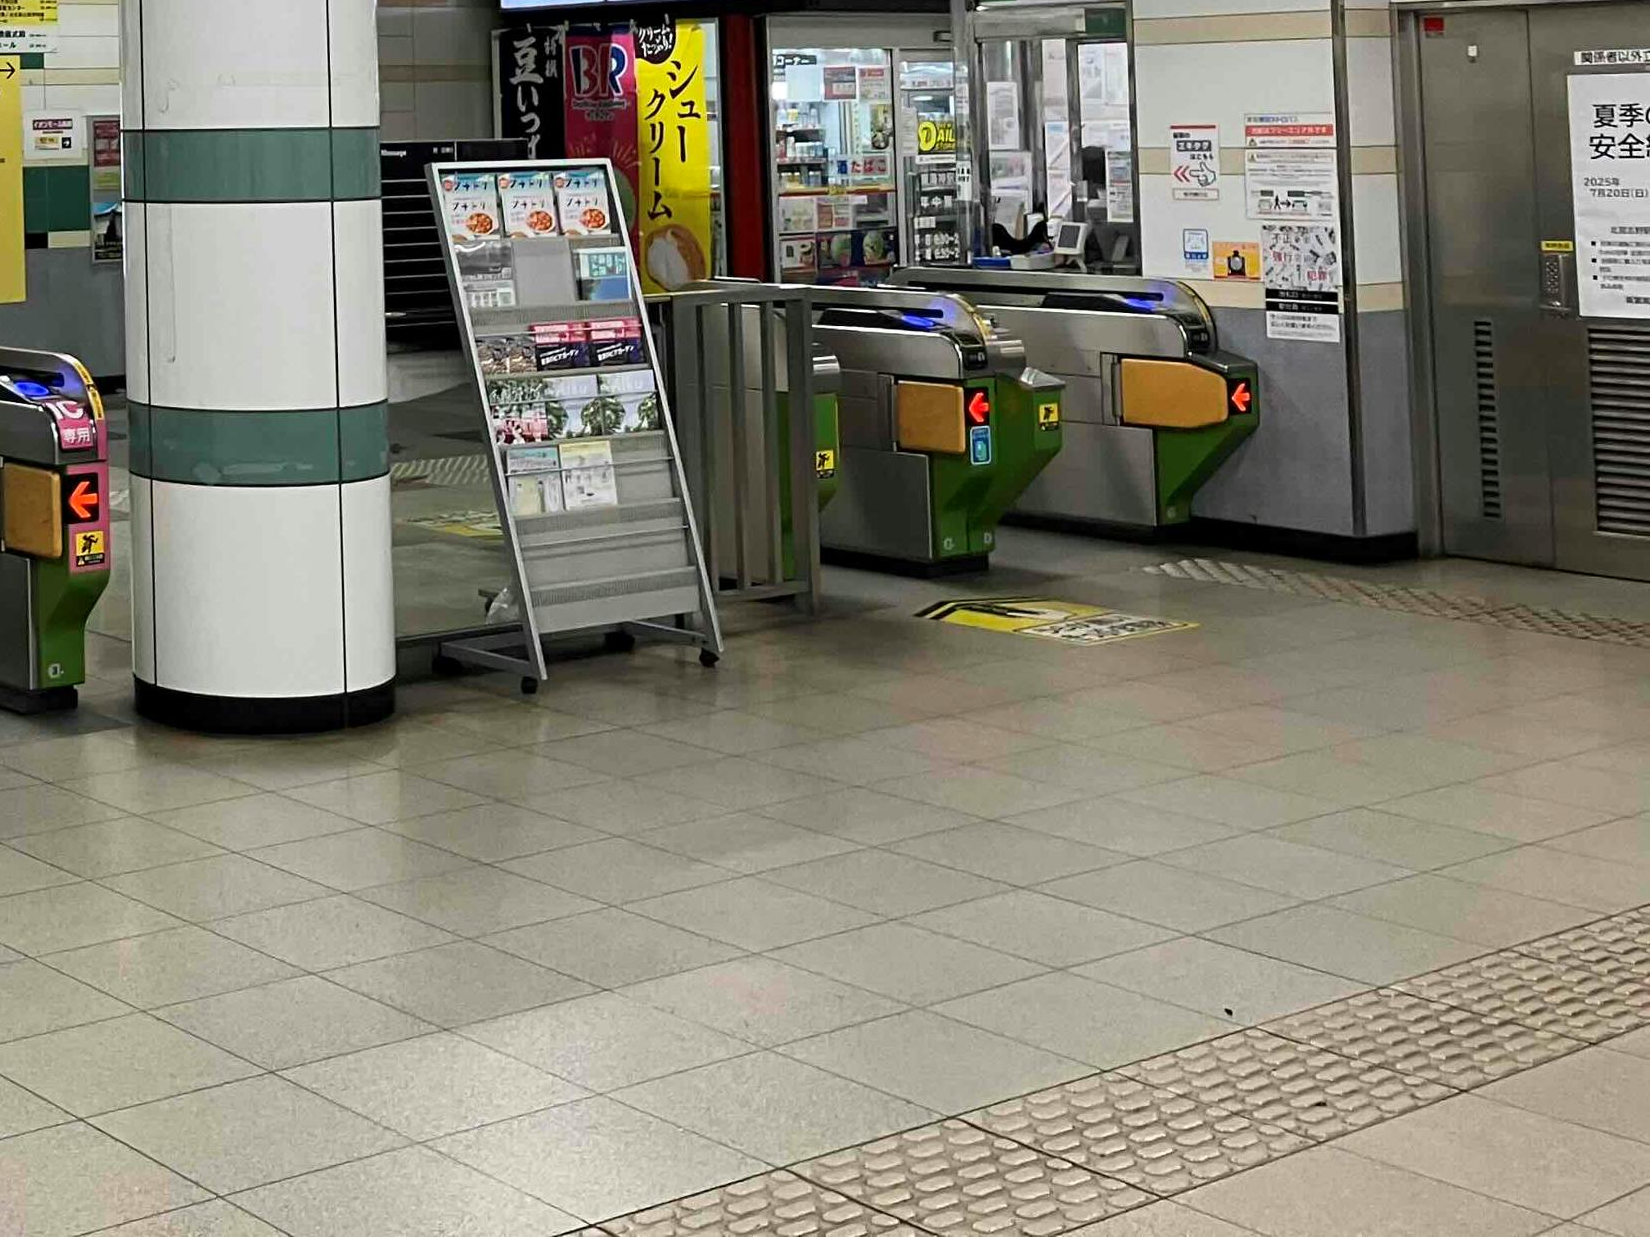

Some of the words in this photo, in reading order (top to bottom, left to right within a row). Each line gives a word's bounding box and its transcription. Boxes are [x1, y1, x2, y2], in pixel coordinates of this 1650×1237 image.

[569, 44, 628, 97] BR
[773, 56, 809, 66] コーナー
[667, 60, 701, 163] シュー
[1591, 103, 1650, 129] 夏季
[919, 121, 956, 151] DAIL
[644, 88, 673, 222] クリーム
[1584, 177, 1620, 187] 2025年
[63, 428, 90, 443] 専用
